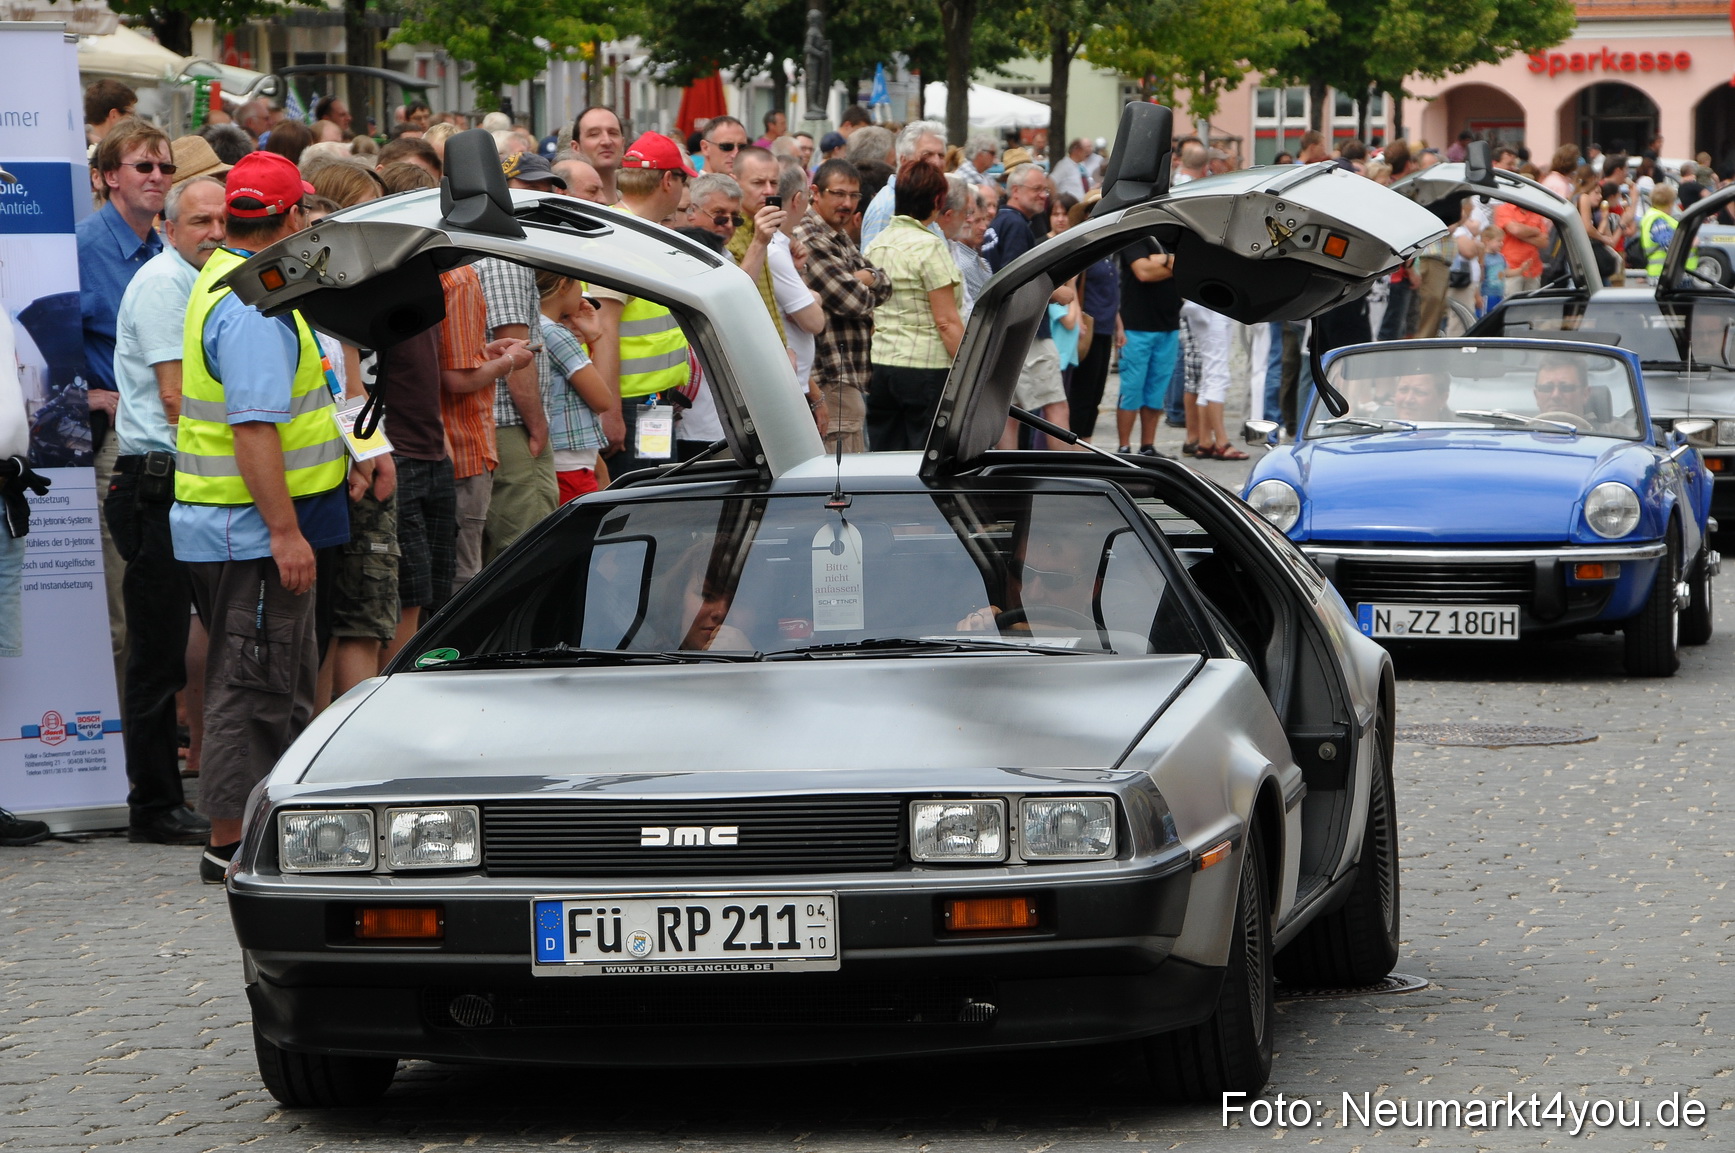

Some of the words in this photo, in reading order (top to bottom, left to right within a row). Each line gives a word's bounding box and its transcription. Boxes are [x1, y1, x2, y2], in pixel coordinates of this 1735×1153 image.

[1528, 46, 1692, 78] Sparkasse
[0, 111, 39, 127] mer
[28, 517, 42, 526] osch
[25, 538, 50, 548] fühlers
[52, 538, 63, 546] der
[21, 560, 37, 569] osch
[39, 559, 53, 568] und
[55, 558, 96, 569] Kugelfischer
[826, 563, 848, 572] Bitte
[825, 573, 849, 582] nicht
[24, 581, 39, 591] und
[40, 580, 93, 590] Instandsetzung
[815, 584, 860, 594] anfassen!
[1375, 609, 1391, 633] N
[1408, 609, 1441, 635] ZZ
[1448, 610, 1516, 636] 180H
[77, 715, 101, 723] BOSCH
[545, 937, 556, 950] D
[568, 906, 622, 954] FÜ
[657, 906, 711, 952] RP
[722, 904, 801, 951] 211
[806, 903, 827, 917] 04
[808, 936, 827, 950] 10
[605, 963, 772, 973] WWW.DELOREANCLUB.DE
